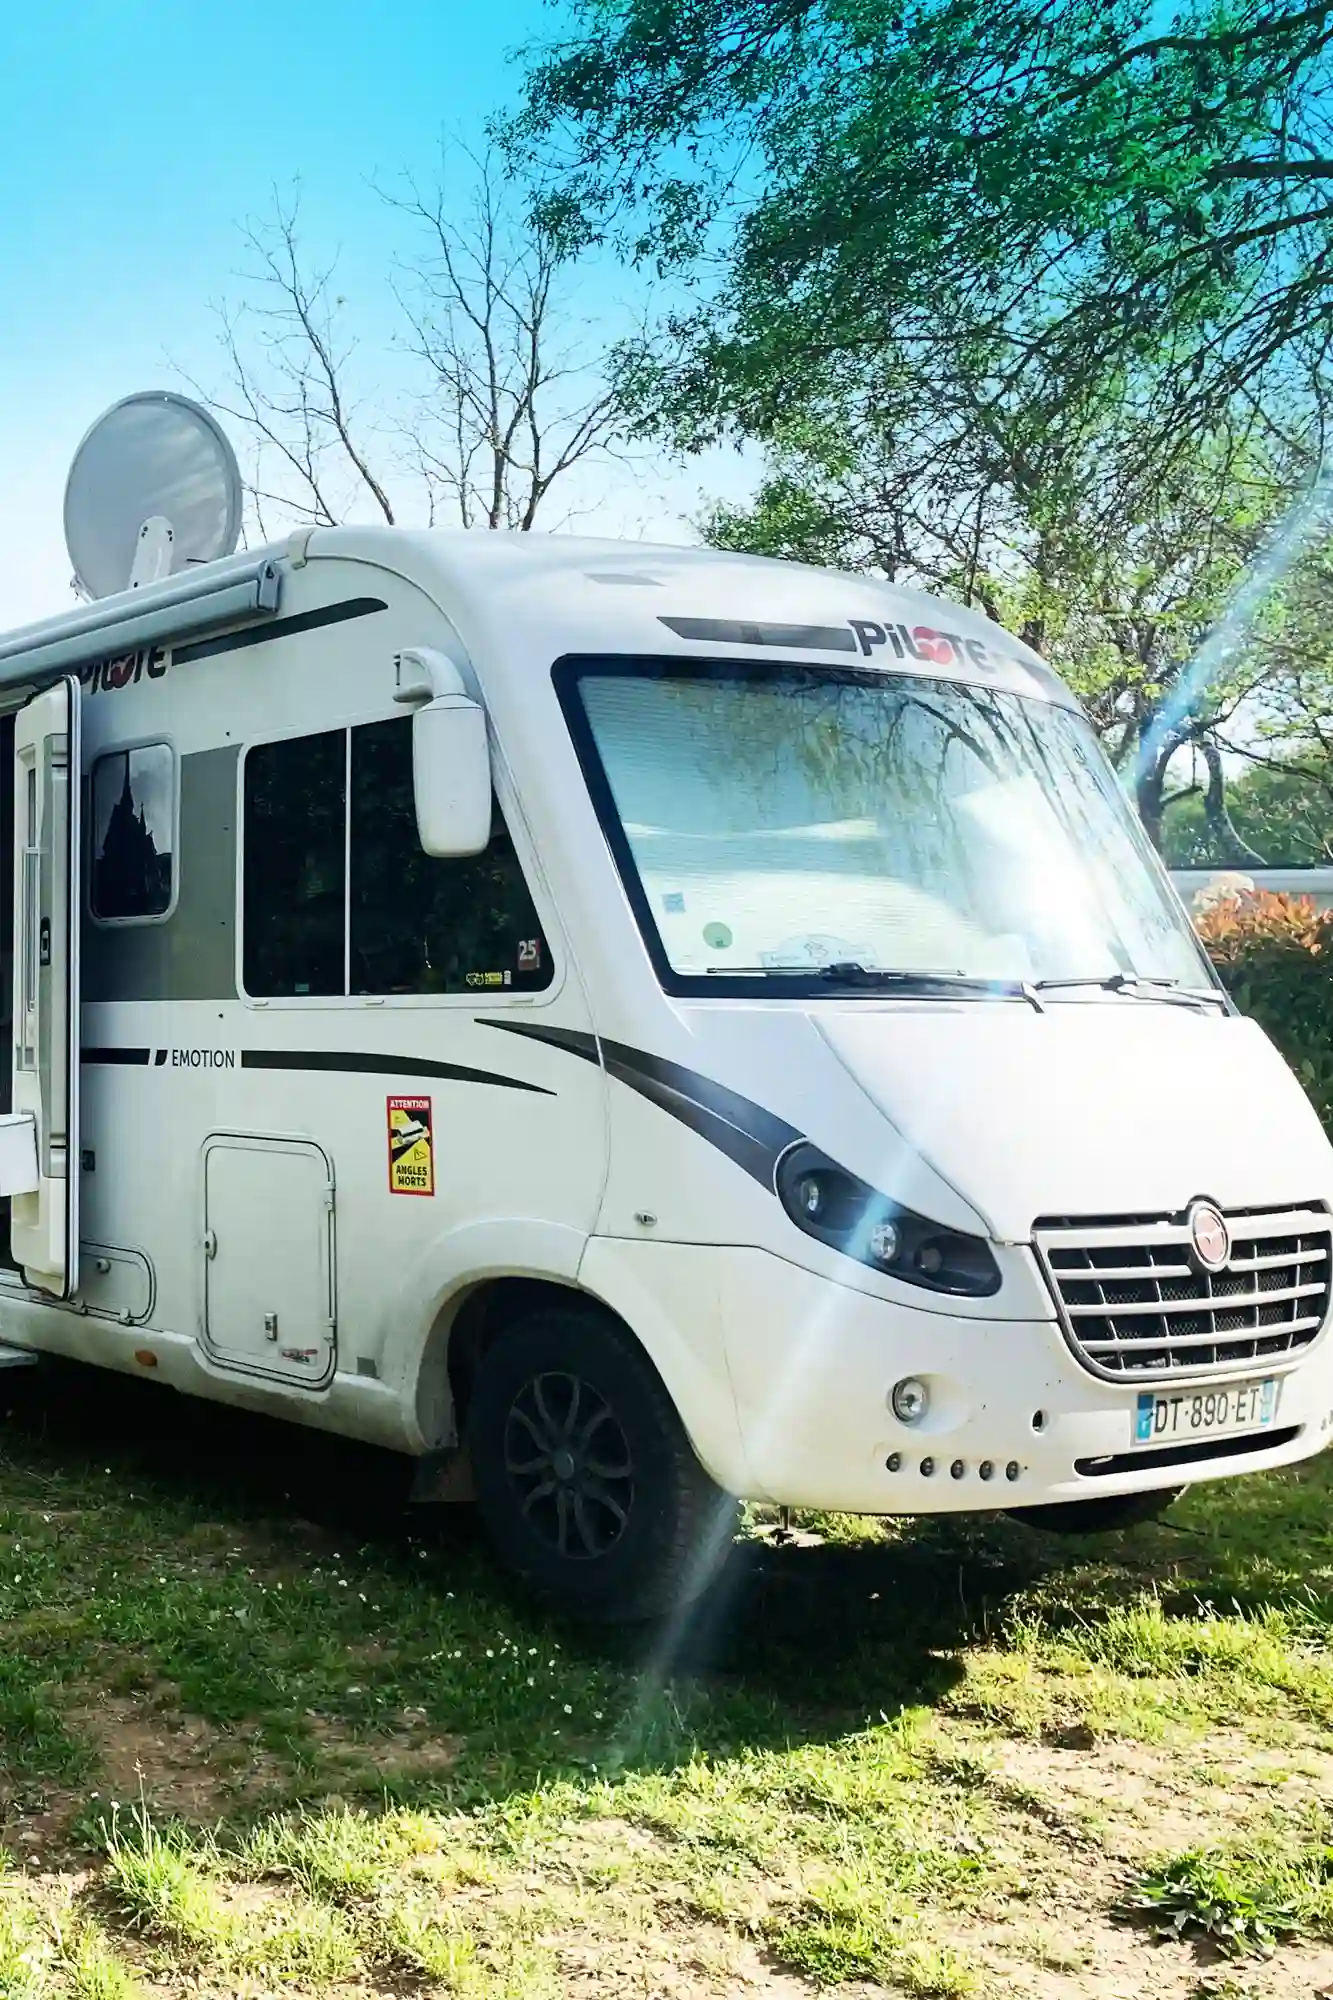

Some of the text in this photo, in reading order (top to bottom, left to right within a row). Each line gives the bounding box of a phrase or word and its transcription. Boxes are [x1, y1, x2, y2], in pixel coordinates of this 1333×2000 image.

[519, 940, 537, 961] 25
[172, 1049, 234, 1068] EMOTION
[396, 1164, 427, 1176] ANGLES
[398, 1175, 426, 1187] MORTS
